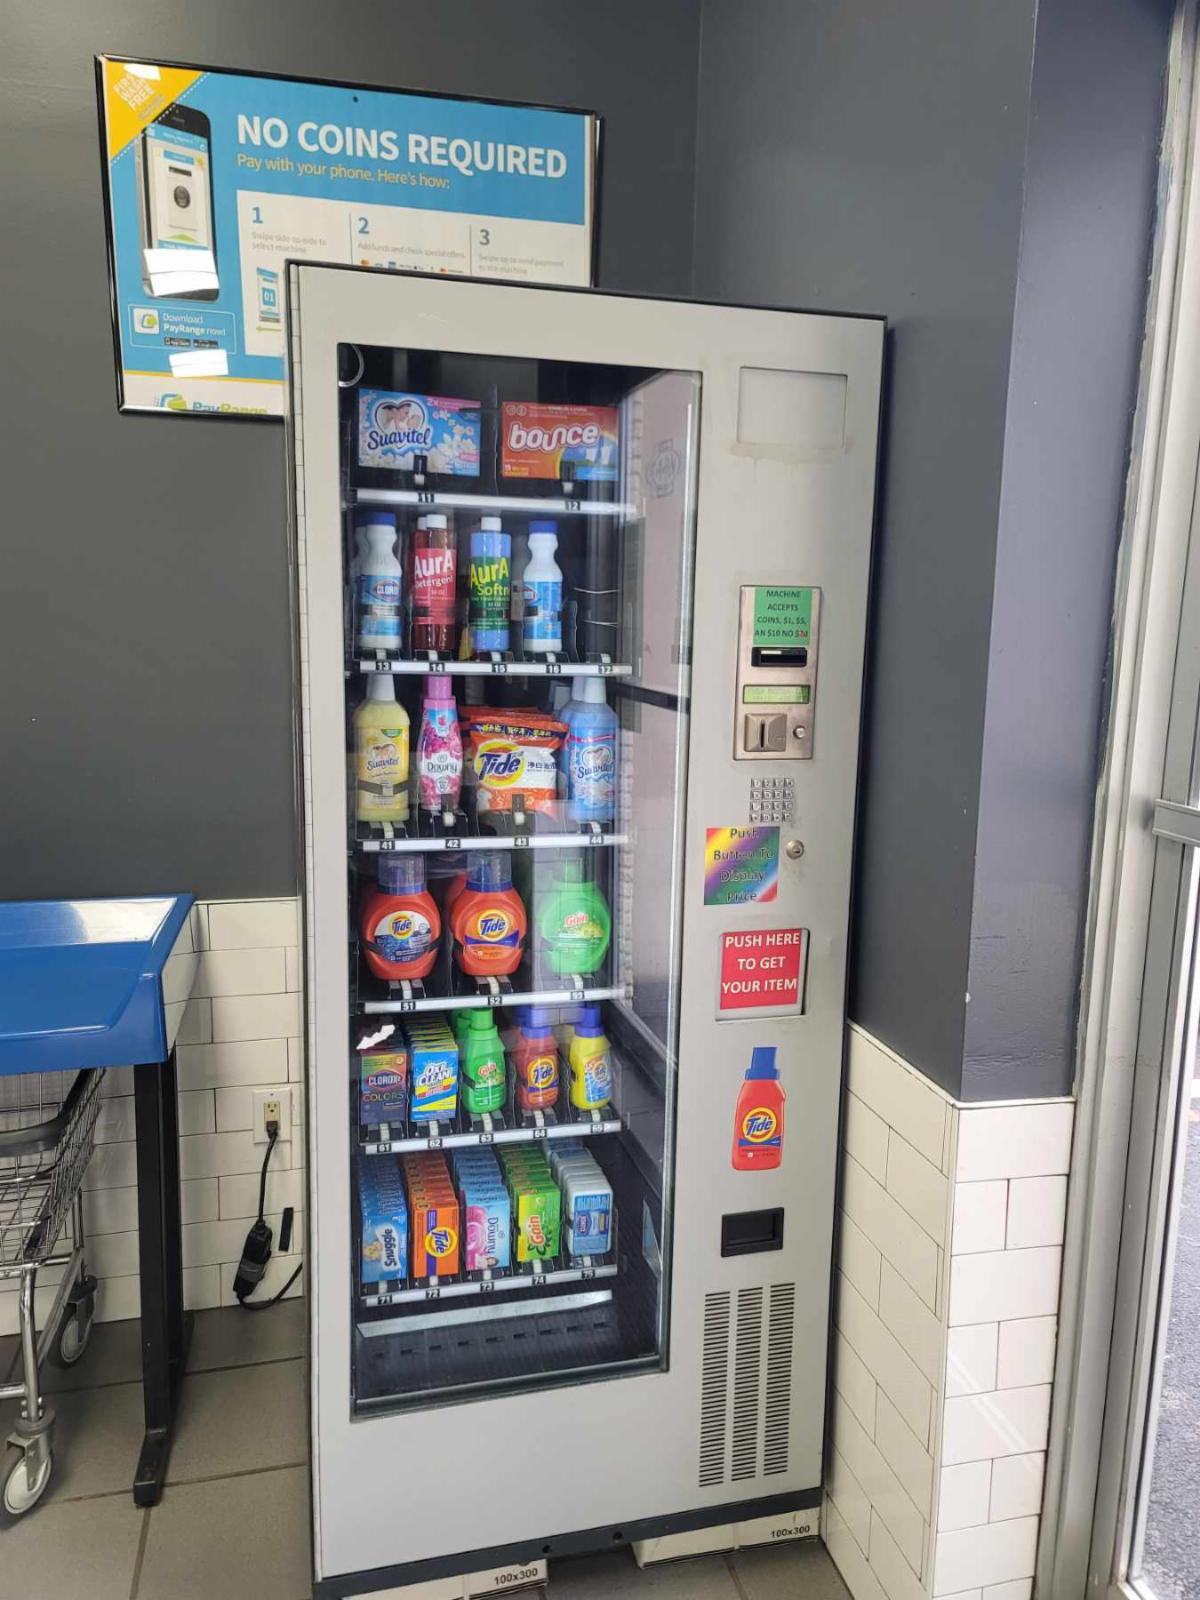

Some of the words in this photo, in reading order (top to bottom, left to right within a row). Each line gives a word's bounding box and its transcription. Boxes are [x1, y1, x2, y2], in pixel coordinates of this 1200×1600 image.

[237, 114, 289, 148] NO
[297, 121, 400, 161] COINS
[408, 133, 567, 178] REQUIRED
[237, 153, 262, 172] Pay
[265, 157, 294, 172] with
[298, 162, 327, 176] your
[330, 165, 374, 181] phone.
[377, 169, 416, 187] Here's
[419, 173, 450, 189] how:
[251, 206, 263, 224] 1
[358, 217, 370, 234] 2
[480, 229, 490, 246] 3
[163, 313, 204, 325] Download
[163, 324, 206, 337] PayRange
[367, 428, 431, 450] Suavitel
[508, 423, 599, 452] bounce
[566, 501, 579, 511] 12
[766, 590, 801, 598] MACHINE
[767, 603, 799, 612] ACCEPTS
[755, 629, 766, 637] AN
[767, 629, 780, 638] $10
[781, 629, 794, 638] NO
[377, 662, 390, 671] 13
[430, 663, 443, 672] 14
[366, 756, 399, 771] Suavitel
[427, 762, 458, 775] Downy
[479, 751, 521, 781] Tide
[577, 762, 613, 779] Suavitel
[730, 828, 759, 839] Push
[381, 840, 394, 850] 41
[446, 839, 459, 848] 42
[515, 839, 528, 847] 43
[727, 892, 757, 902] Price
[392, 919, 412, 934] Tide
[480, 918, 506, 936] Tide
[565, 913, 589, 927] Gain
[725, 934, 762, 948] PUSH
[766, 932, 800, 946] HERE
[737, 958, 756, 970] TO
[759, 956, 786, 969] GET
[722, 980, 760, 994] YOUR
[764, 978, 798, 992] ITEM
[402, 1002, 414, 1010] 51
[479, 1063, 497, 1077] Gain
[532, 1066, 553, 1084] Tide
[418, 1070, 452, 1086] CLEAN
[362, 1092, 405, 1101] COLORS
[534, 1129, 546, 1138] 64
[746, 1116, 773, 1137] Tide
[429, 1139, 441, 1148] 62
[480, 1134, 492, 1143] 63
[379, 1144, 390, 1152] 61
[486, 1216, 499, 1255] Downy
[528, 1215, 545, 1245] Gain
[384, 1228, 397, 1267] Snuggle
[431, 1229, 448, 1254] Tide
[481, 1283, 493, 1291] 73
[533, 1276, 545, 1285] 74
[379, 1296, 391, 1305] 71
[427, 1290, 439, 1299] 72
[770, 1525, 811, 1539] 100x300
[493, 1567, 539, 1586] 100x300
